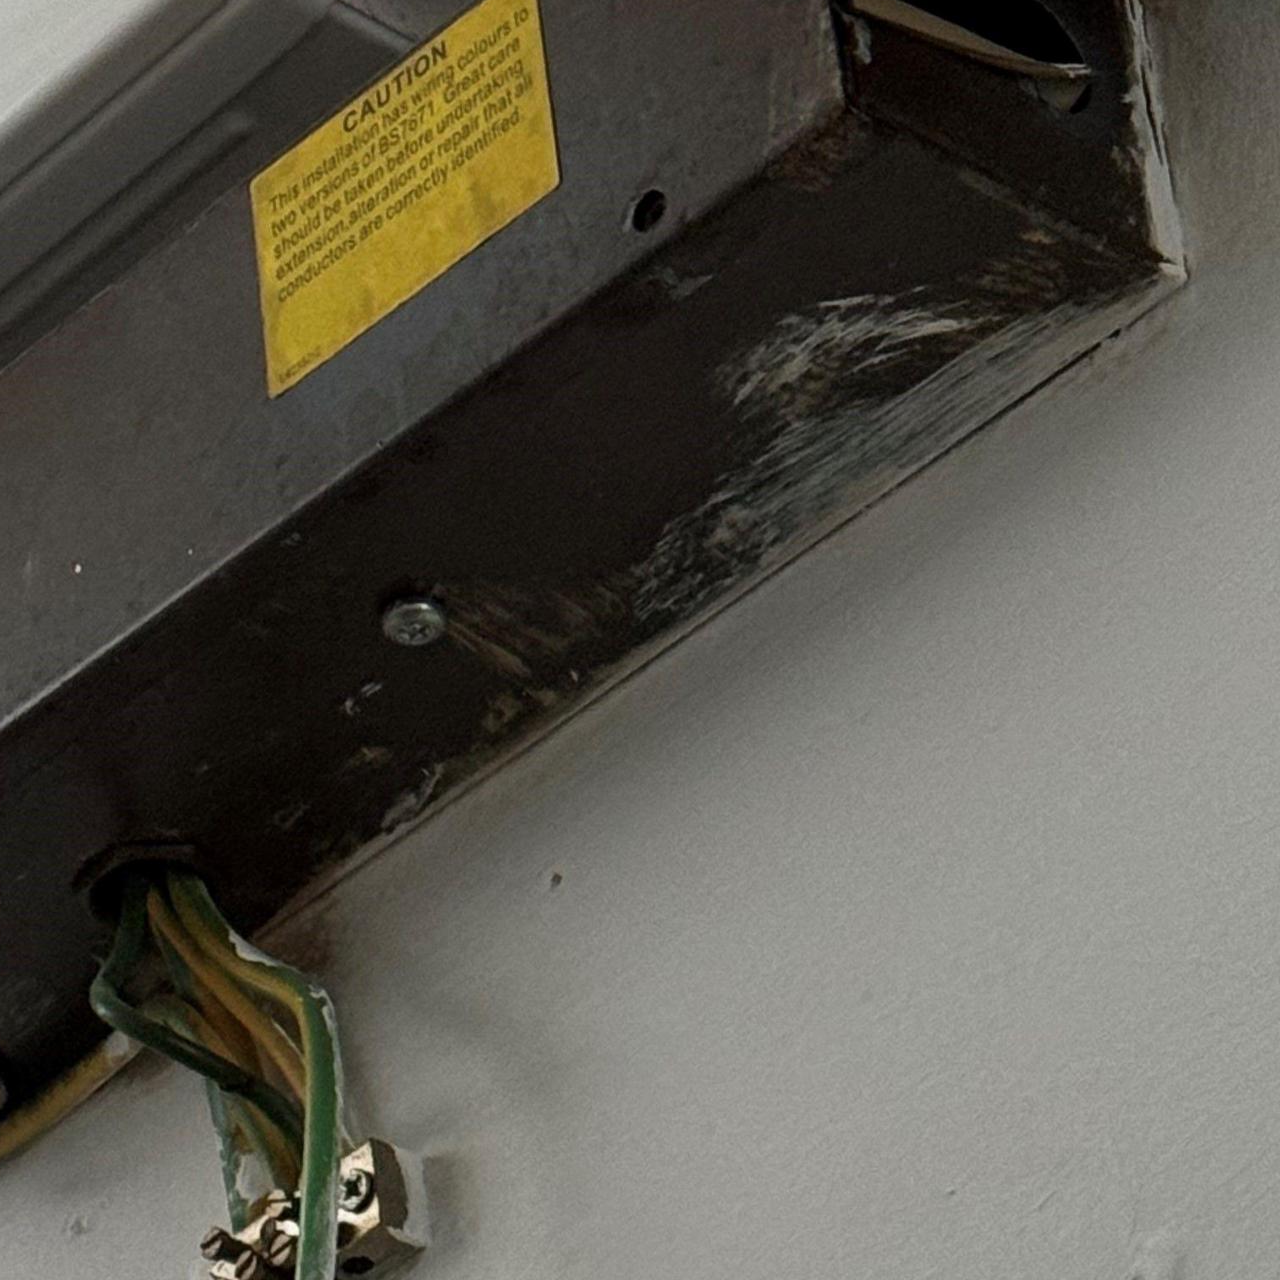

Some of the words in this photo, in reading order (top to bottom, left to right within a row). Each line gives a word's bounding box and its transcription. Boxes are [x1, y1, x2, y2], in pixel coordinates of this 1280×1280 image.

[269, 179, 298, 217] This
[301, 117, 379, 193] installation
[381, 95, 407, 131] has
[456, 15, 511, 73] colours
[514, 3, 529, 29] to
[272, 205, 297, 239] two
[299, 158, 359, 217] versions
[361, 143, 376, 169] of
[443, 60, 485, 106] Great
[488, 35, 520, 72] care
[274, 210, 320, 261] should
[323, 195, 340, 222] be
[343, 161, 384, 207] taken
[386, 124, 433, 174] before
[435, 54, 524, 138] undertaking
[342, 37, 447, 137] CAUTION
[419, 150, 434, 174] or
[436, 112, 480, 162] repair
[483, 86, 512, 123] that
[513, 70, 532, 99] all
[278, 231, 355, 306] conductors
[358, 212, 383, 244] are
[385, 160, 449, 225] correctly
